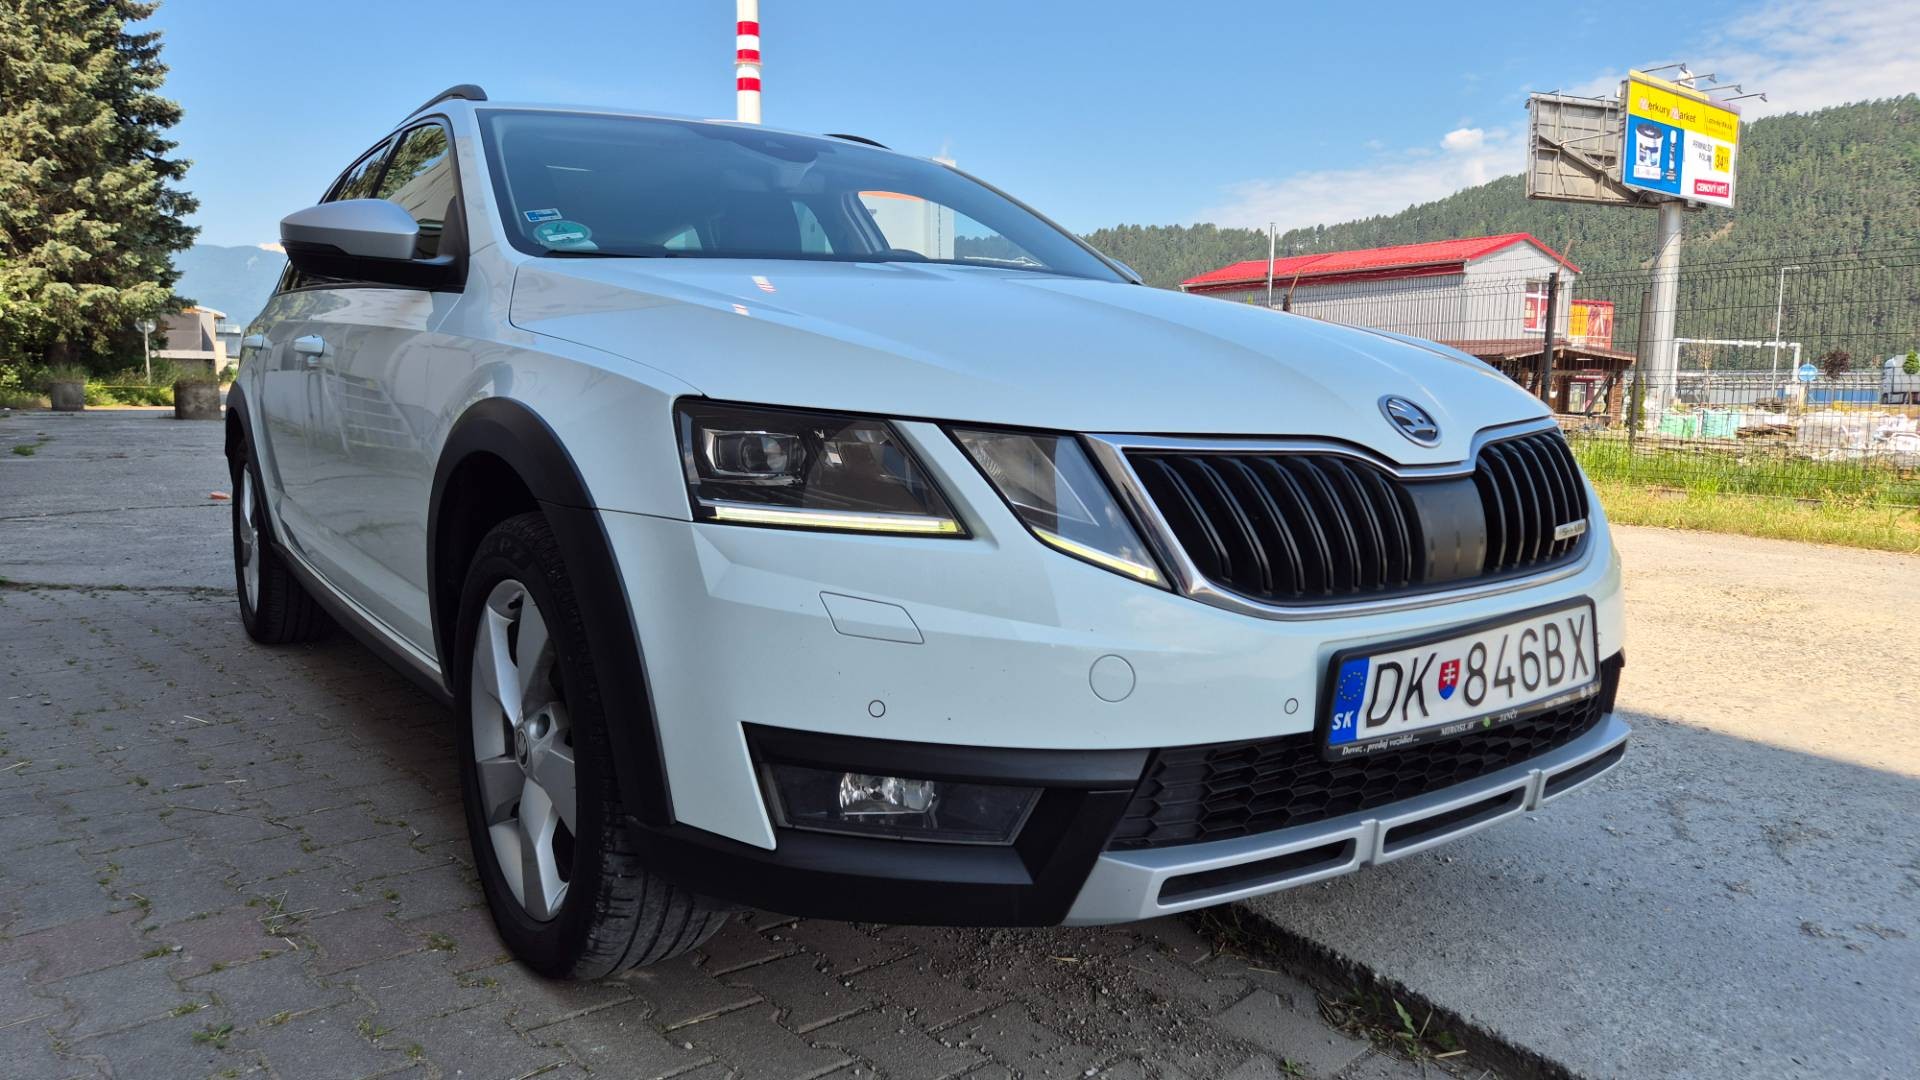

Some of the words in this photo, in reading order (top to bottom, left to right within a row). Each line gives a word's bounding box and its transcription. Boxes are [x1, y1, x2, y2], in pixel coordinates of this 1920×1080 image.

[1639, 97, 1670, 117] Merkury
[1671, 107, 1697, 123] Market
[1366, 652, 1438, 727] DK
[1463, 614, 1589, 706] 846BX
[1331, 710, 1354, 730] SK
